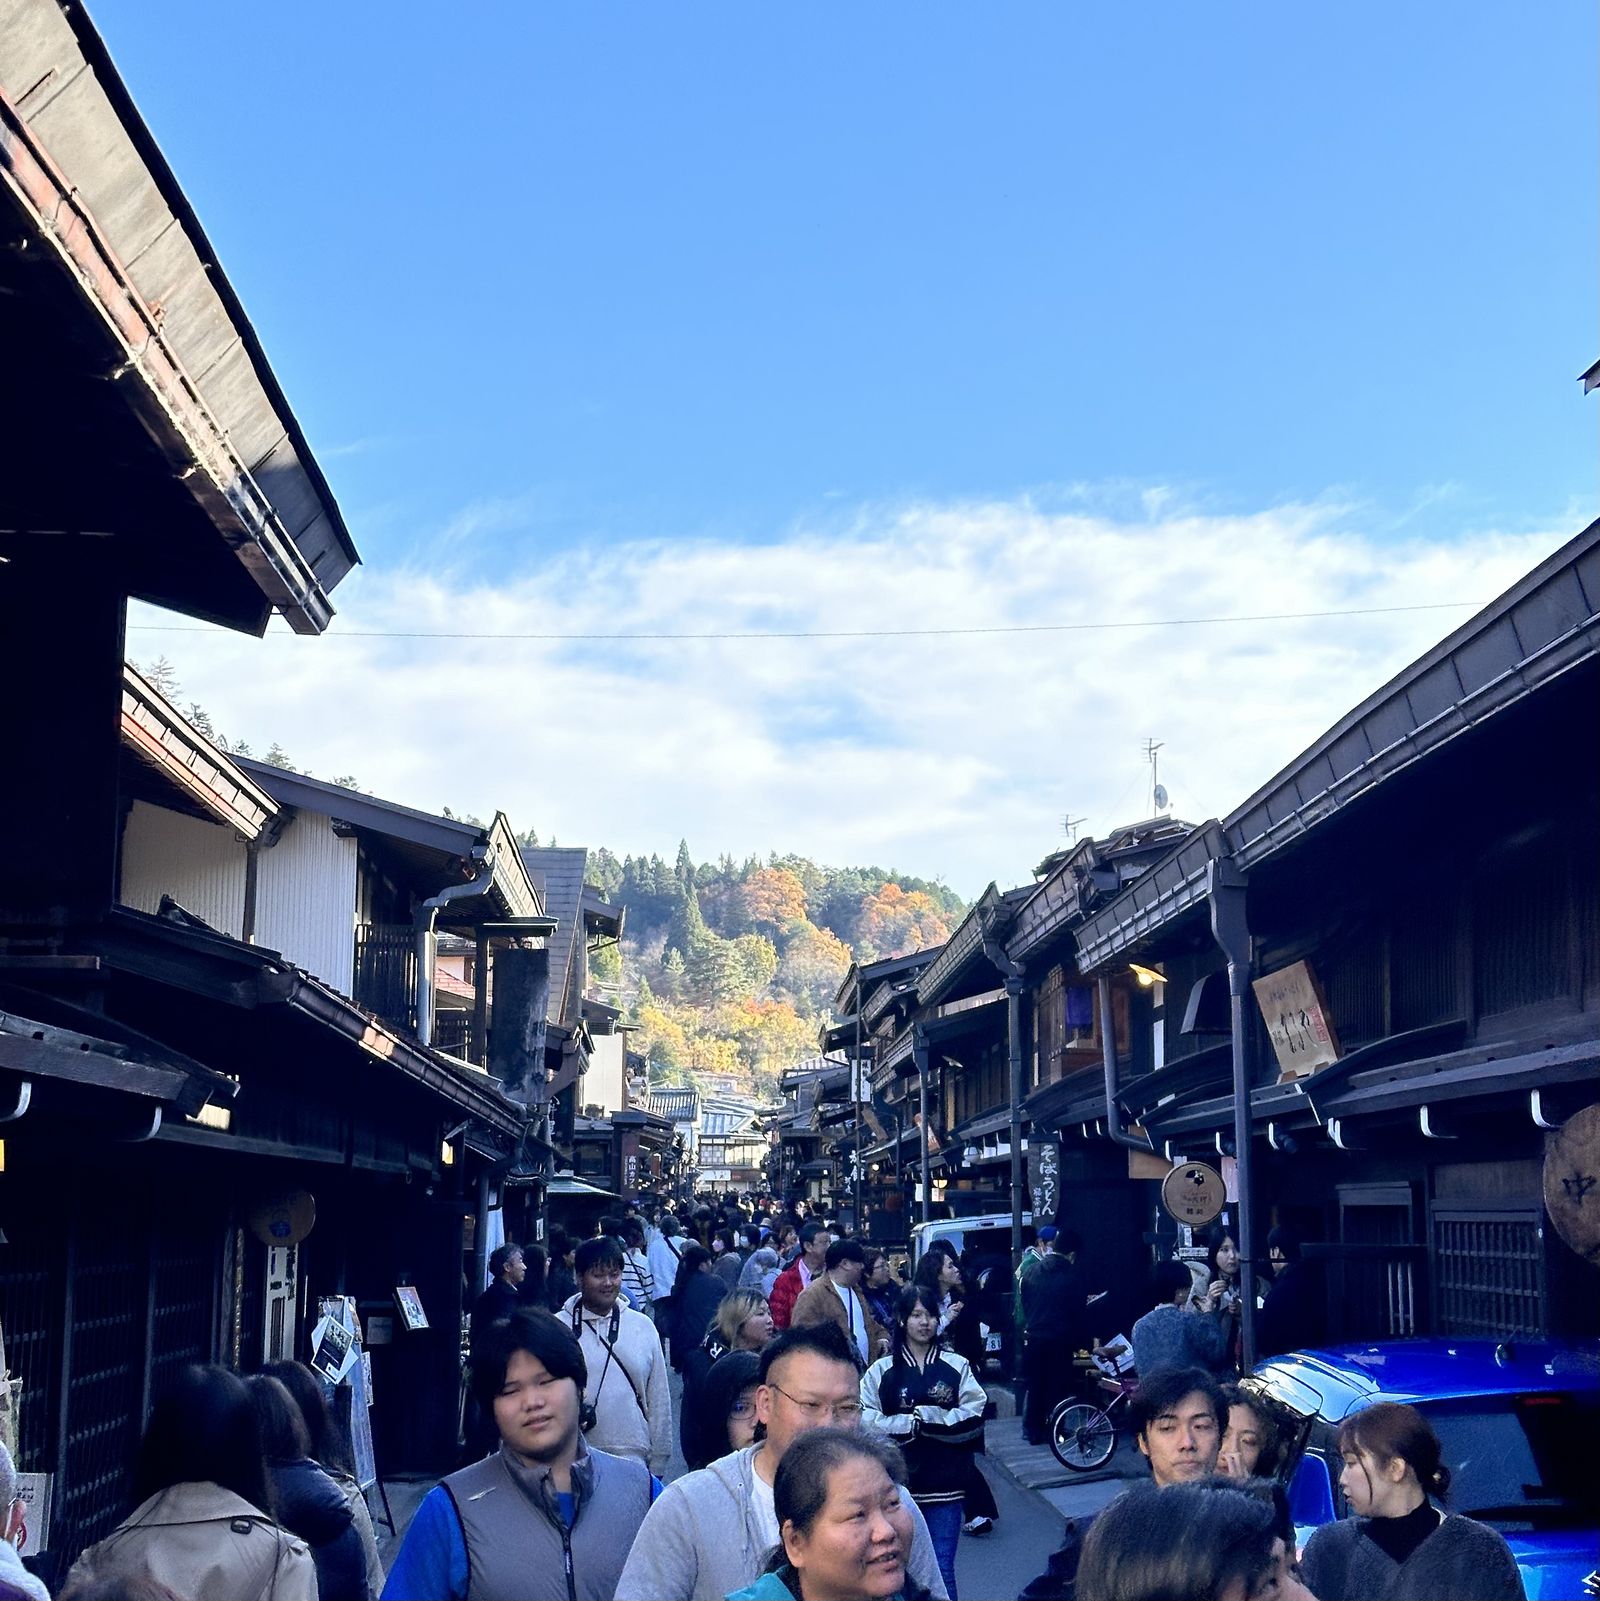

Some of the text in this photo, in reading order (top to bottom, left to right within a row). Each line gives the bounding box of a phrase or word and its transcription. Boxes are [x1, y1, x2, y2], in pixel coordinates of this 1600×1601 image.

[1040, 1144, 1058, 1216] そばうどん
